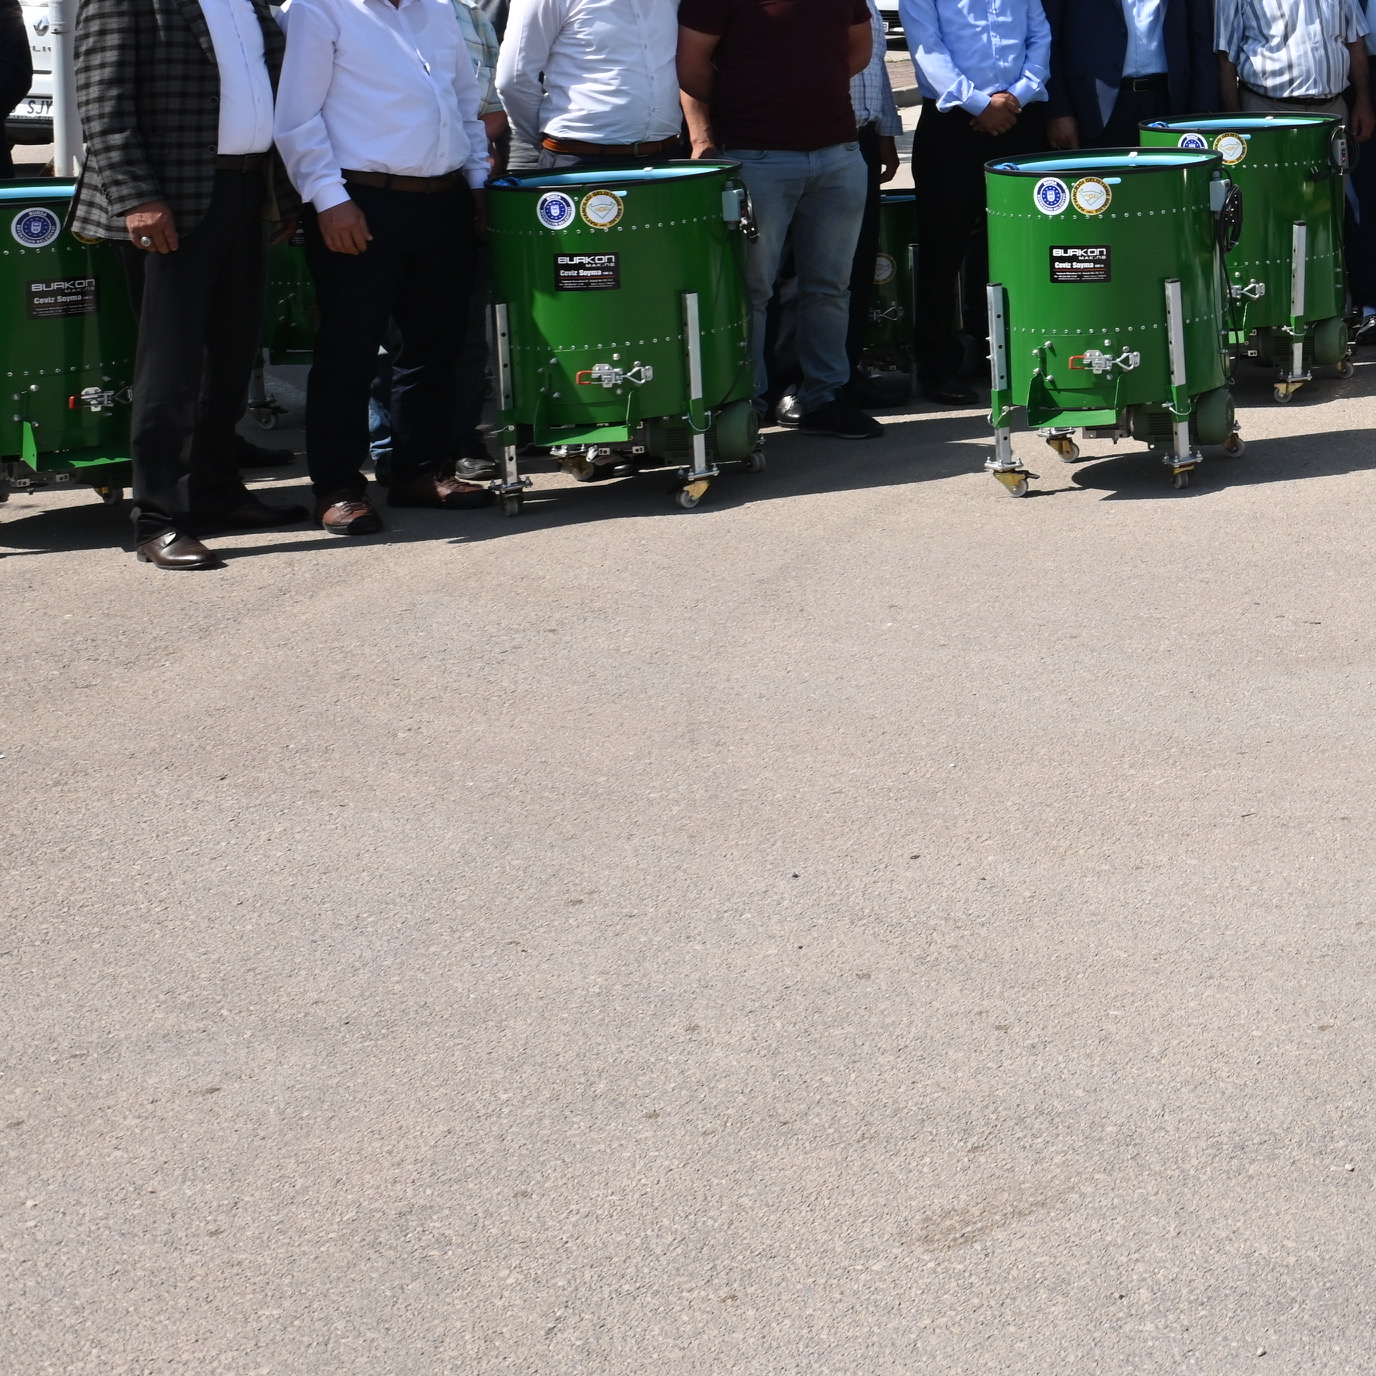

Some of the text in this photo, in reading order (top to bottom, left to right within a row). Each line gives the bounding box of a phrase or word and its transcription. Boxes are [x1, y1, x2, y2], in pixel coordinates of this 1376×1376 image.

[1053, 248, 1106, 256] BURKON
[558, 255, 615, 264] BURKON
[31, 279, 96, 292] BURKON
